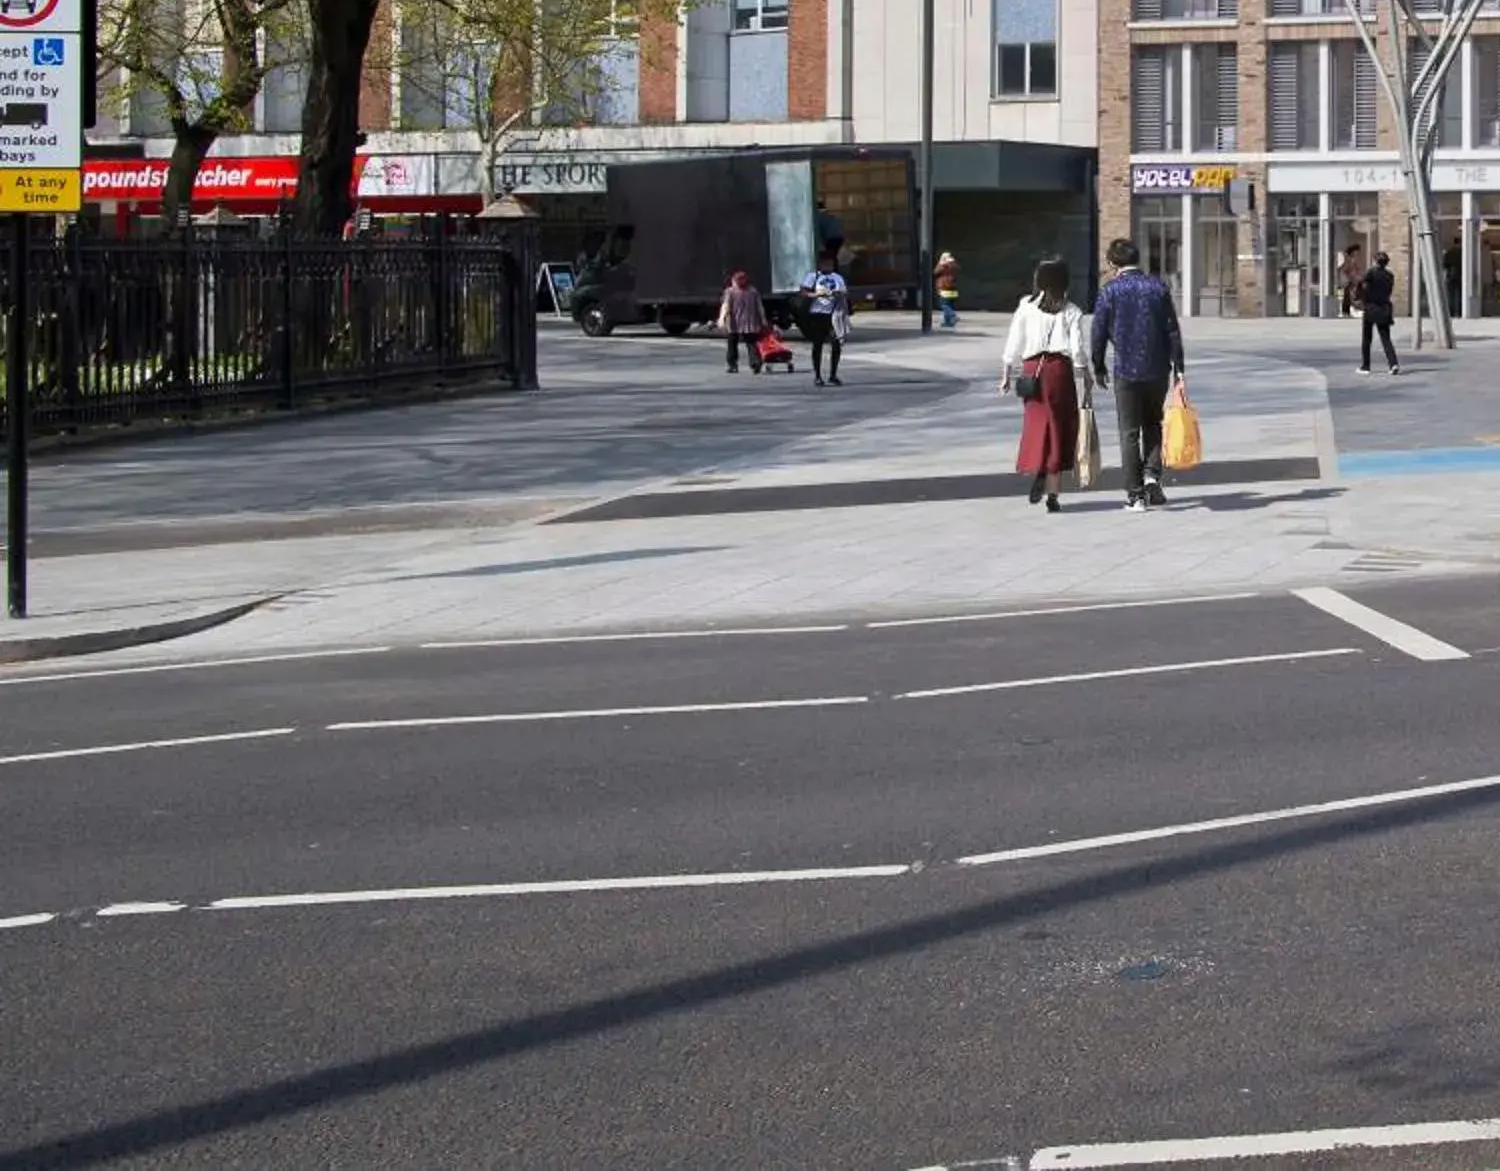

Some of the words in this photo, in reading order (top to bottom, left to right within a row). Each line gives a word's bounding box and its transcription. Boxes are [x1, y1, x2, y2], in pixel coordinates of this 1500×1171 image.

[0, 45, 28, 59] ept
[24, 69, 46, 81] for
[41, 85, 59, 97] by
[543, 163, 605, 185] SPOR
[1455, 168, 1488, 183] THE
[15, 176, 33, 188] At
[39, 178, 67, 189] any
[23, 192, 58, 203] time
